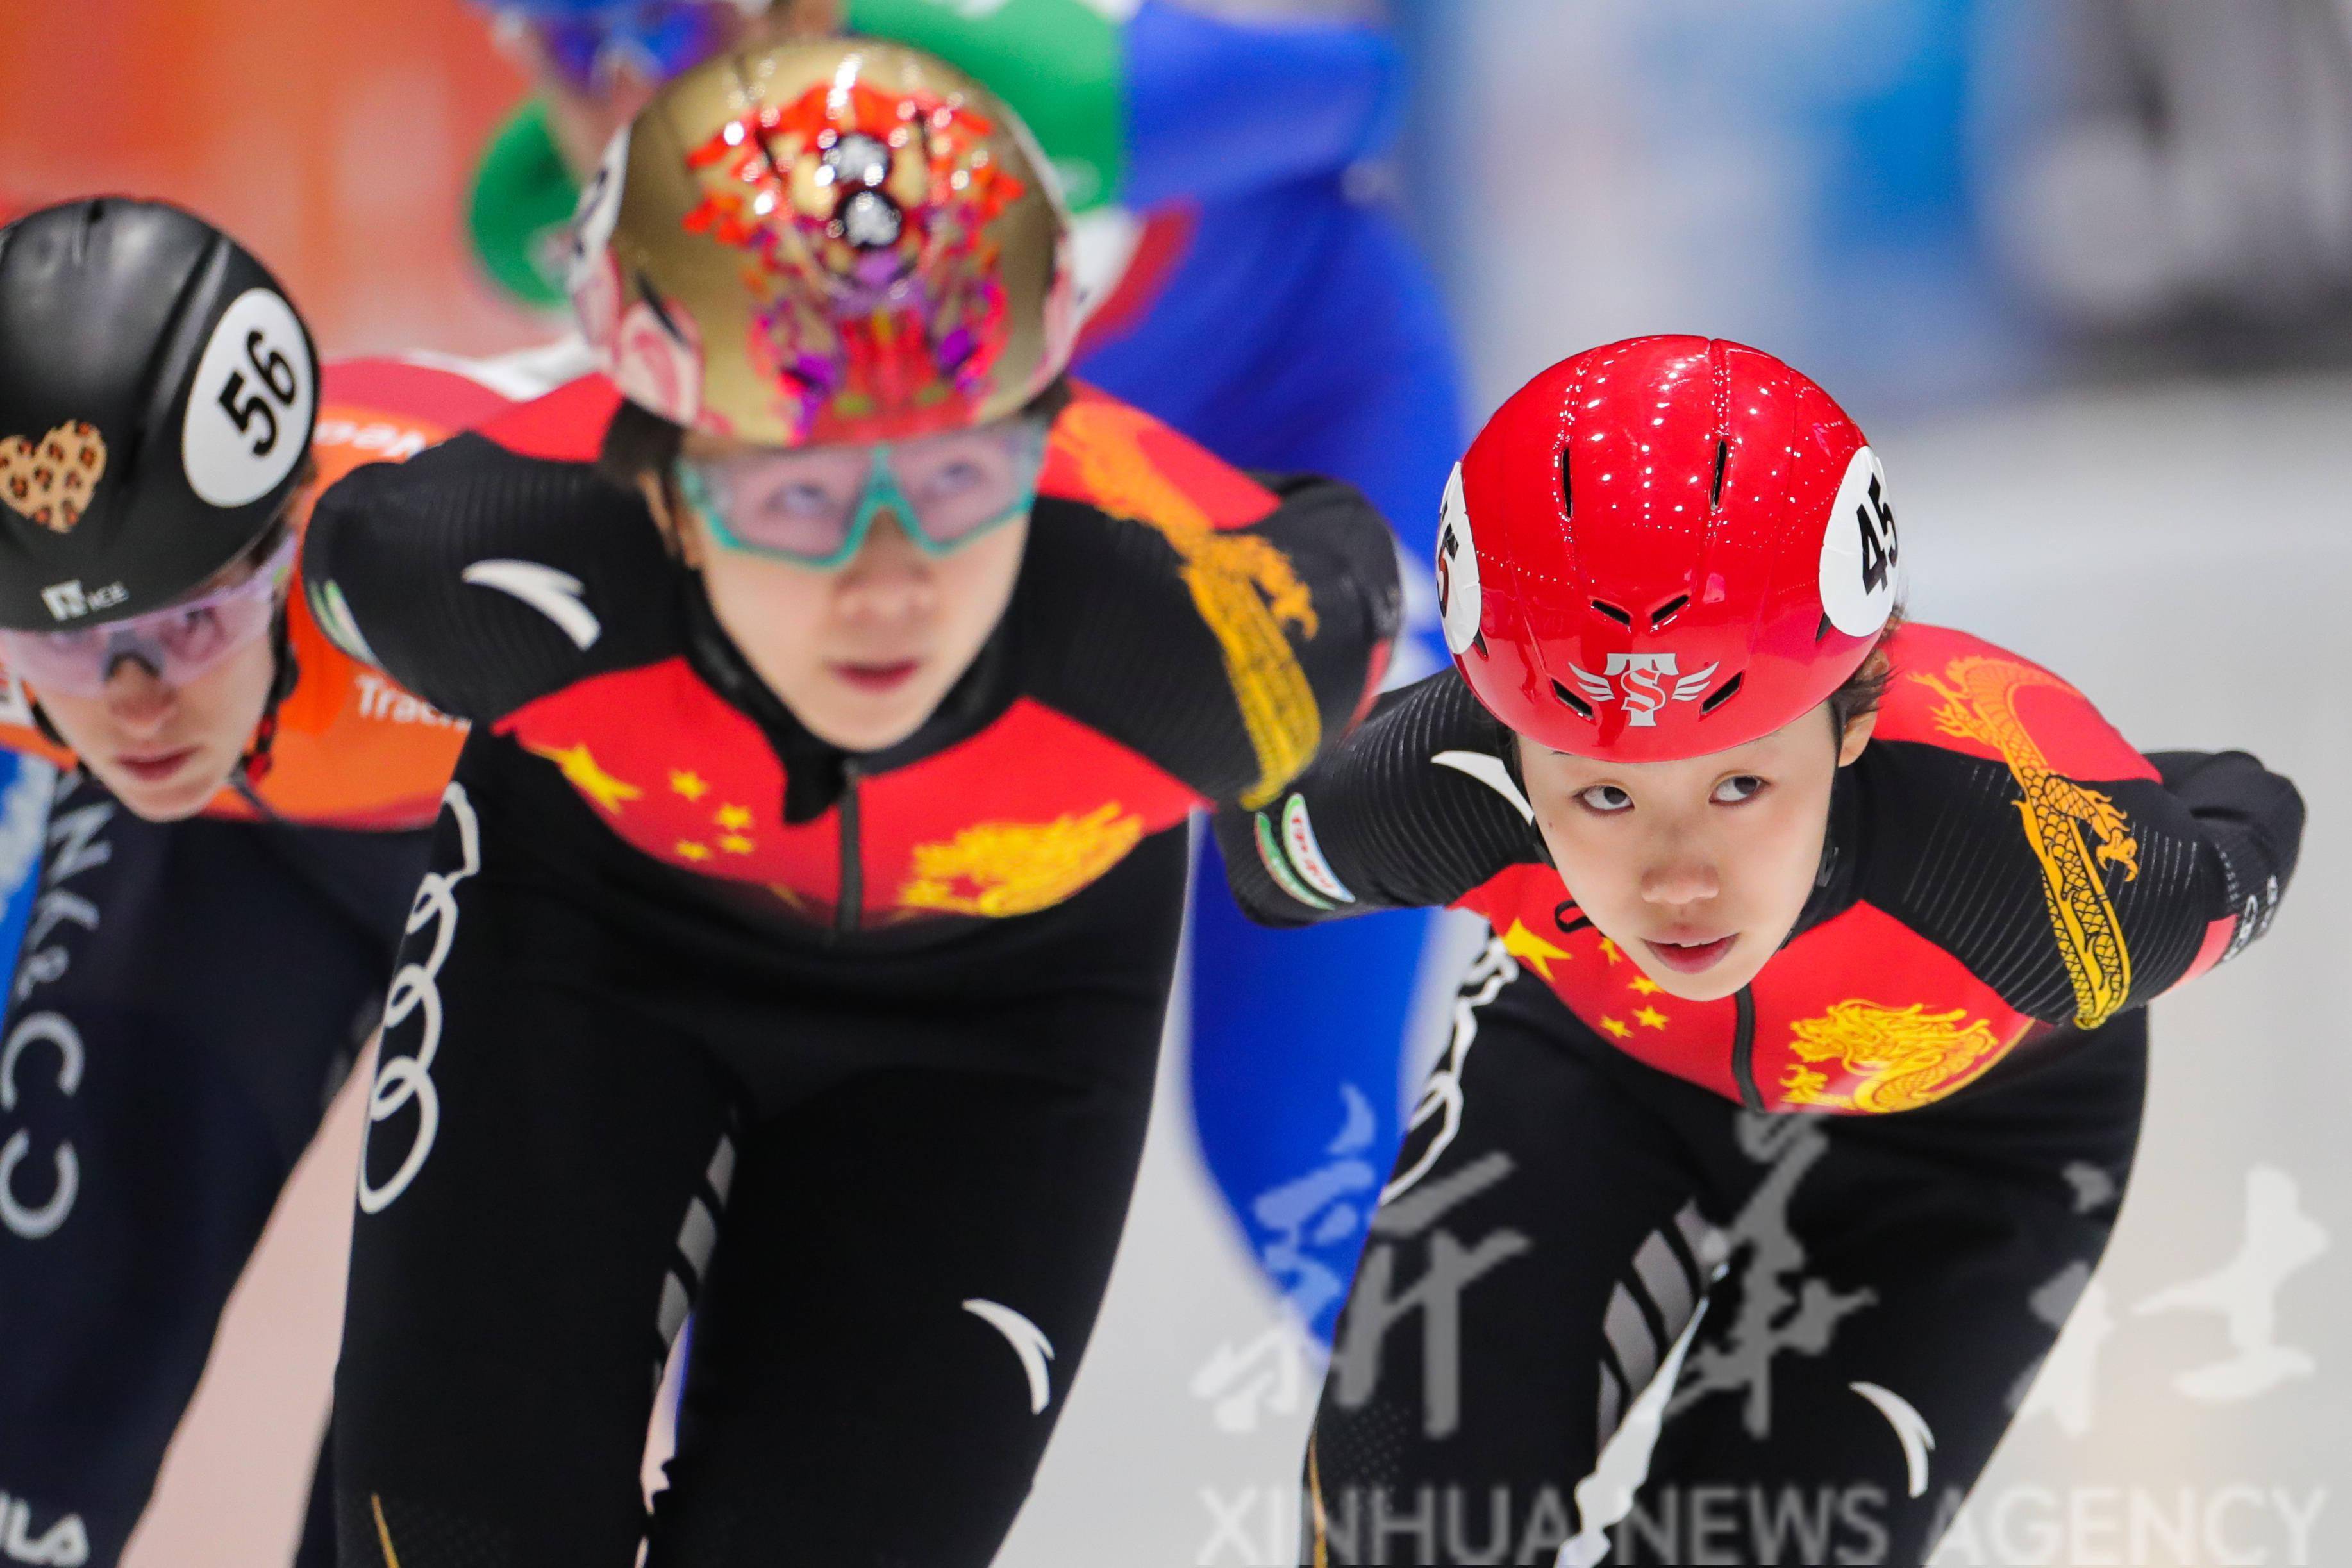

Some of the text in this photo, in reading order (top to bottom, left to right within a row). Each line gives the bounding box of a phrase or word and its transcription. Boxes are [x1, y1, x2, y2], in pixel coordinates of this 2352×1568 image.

[218, 330, 296, 456] 56
[1437, 500, 1460, 619] 5
[1856, 472, 1899, 596] 45
